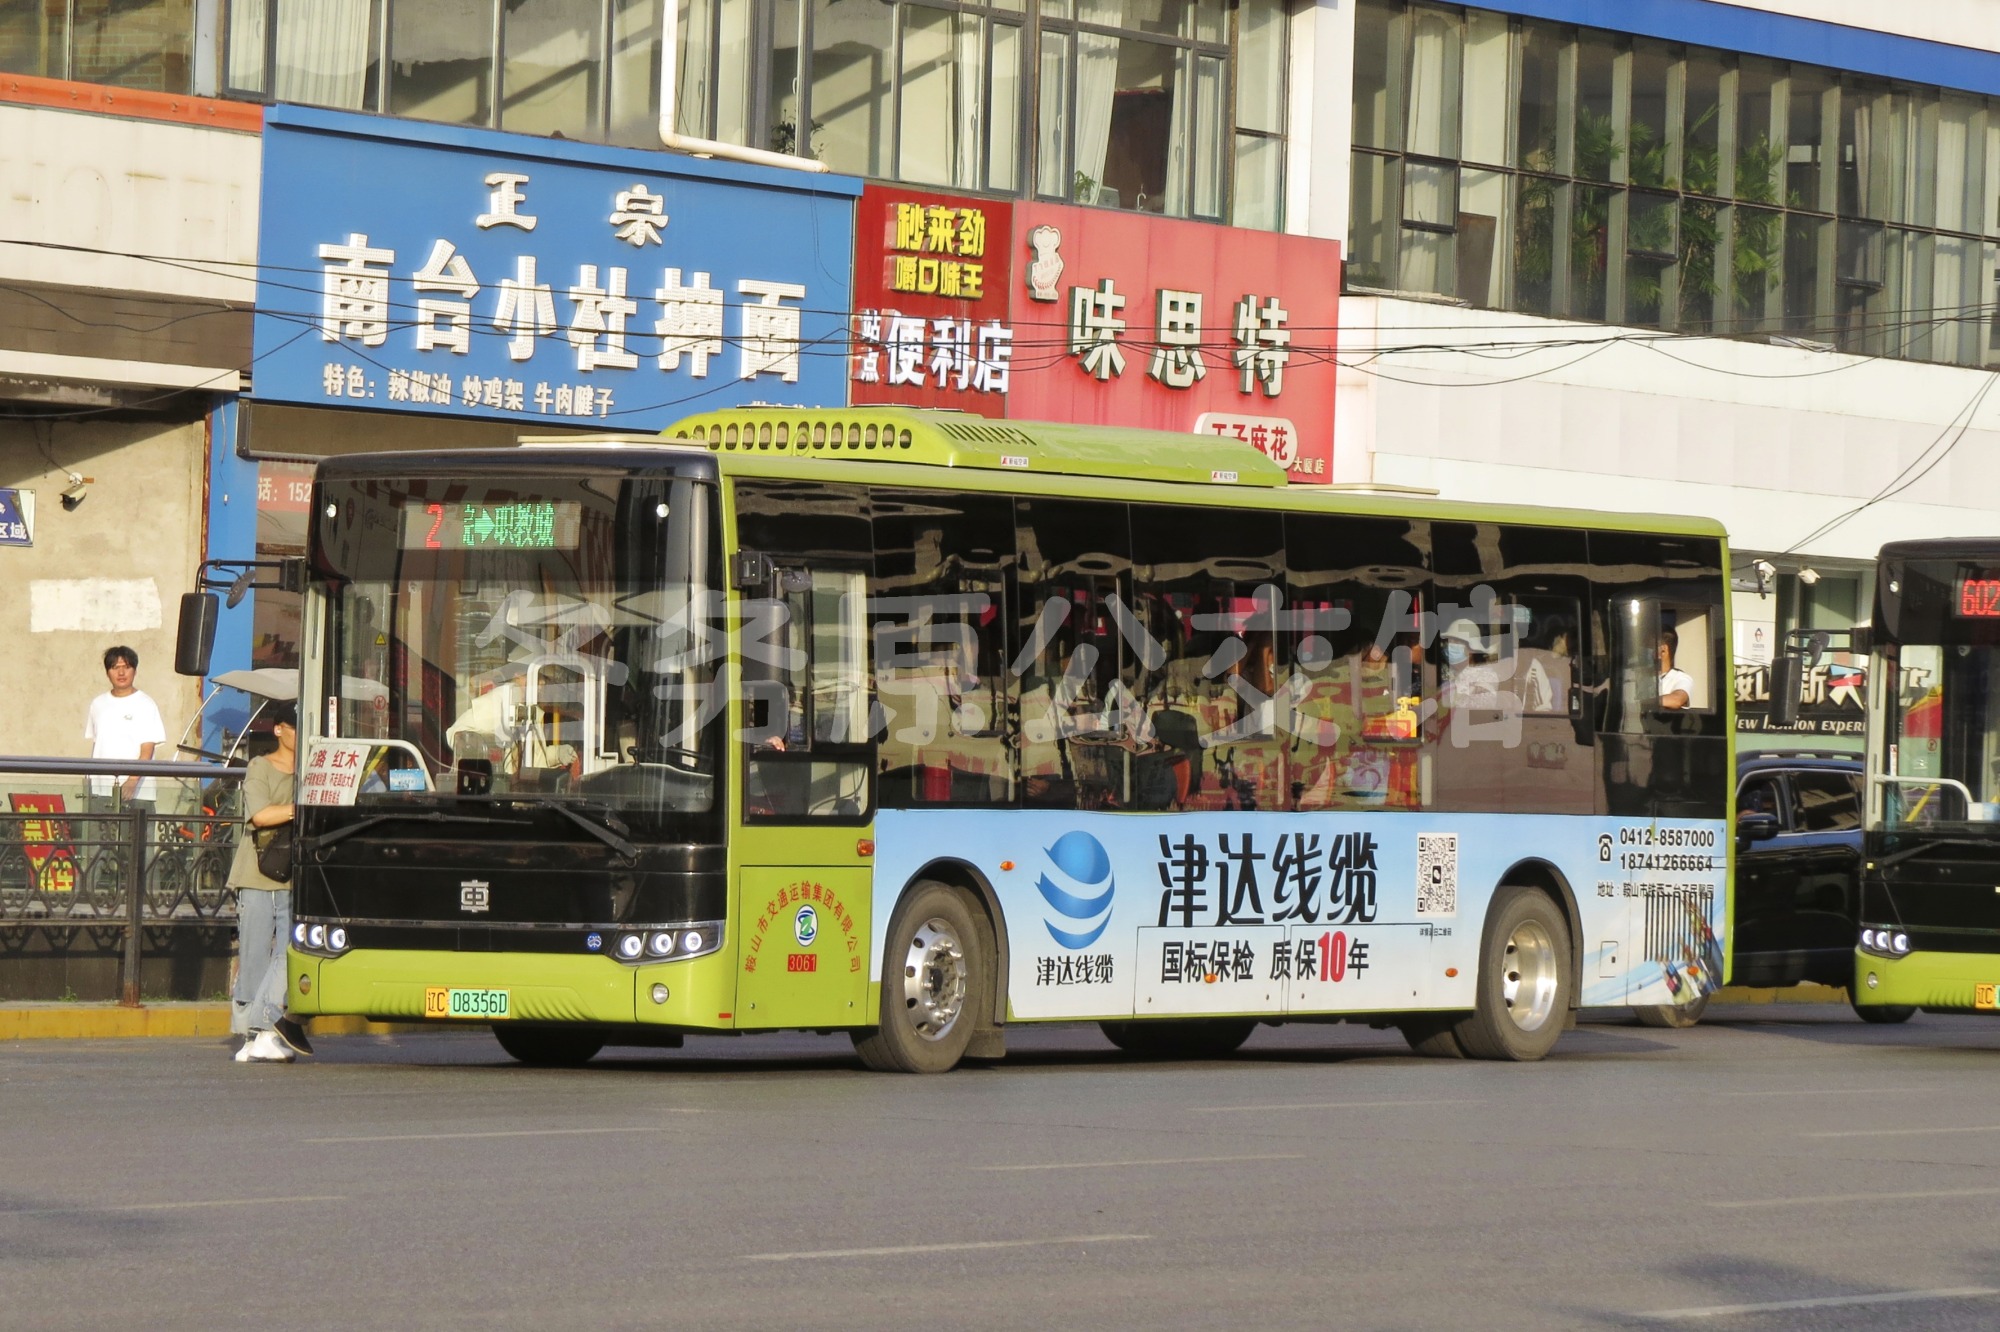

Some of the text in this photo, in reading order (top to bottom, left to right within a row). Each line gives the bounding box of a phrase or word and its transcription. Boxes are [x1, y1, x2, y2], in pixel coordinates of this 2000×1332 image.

[895, 204, 985, 257] 秒来劲
[884, 311, 1013, 393] 便利店
[1069, 279, 1291, 397] 味思特
[462, 374, 524, 411] 炒鸡架
[534, 381, 614, 418] 牛肉腱子
[425, 504, 443, 548] 2
[1620, 828, 1714, 847] 0412-8587000
[1158, 832, 1378, 927] 津达线缆
[1621, 854, 1713, 871] 18741266664
[745, 880, 861, 973] 鞍山市交通运输集团有限公司
[788, 954, 817, 972] 3061
[1036, 954, 1114, 986] 津达线缆
[1161, 930, 1370, 984] 国标保检 质保10年
